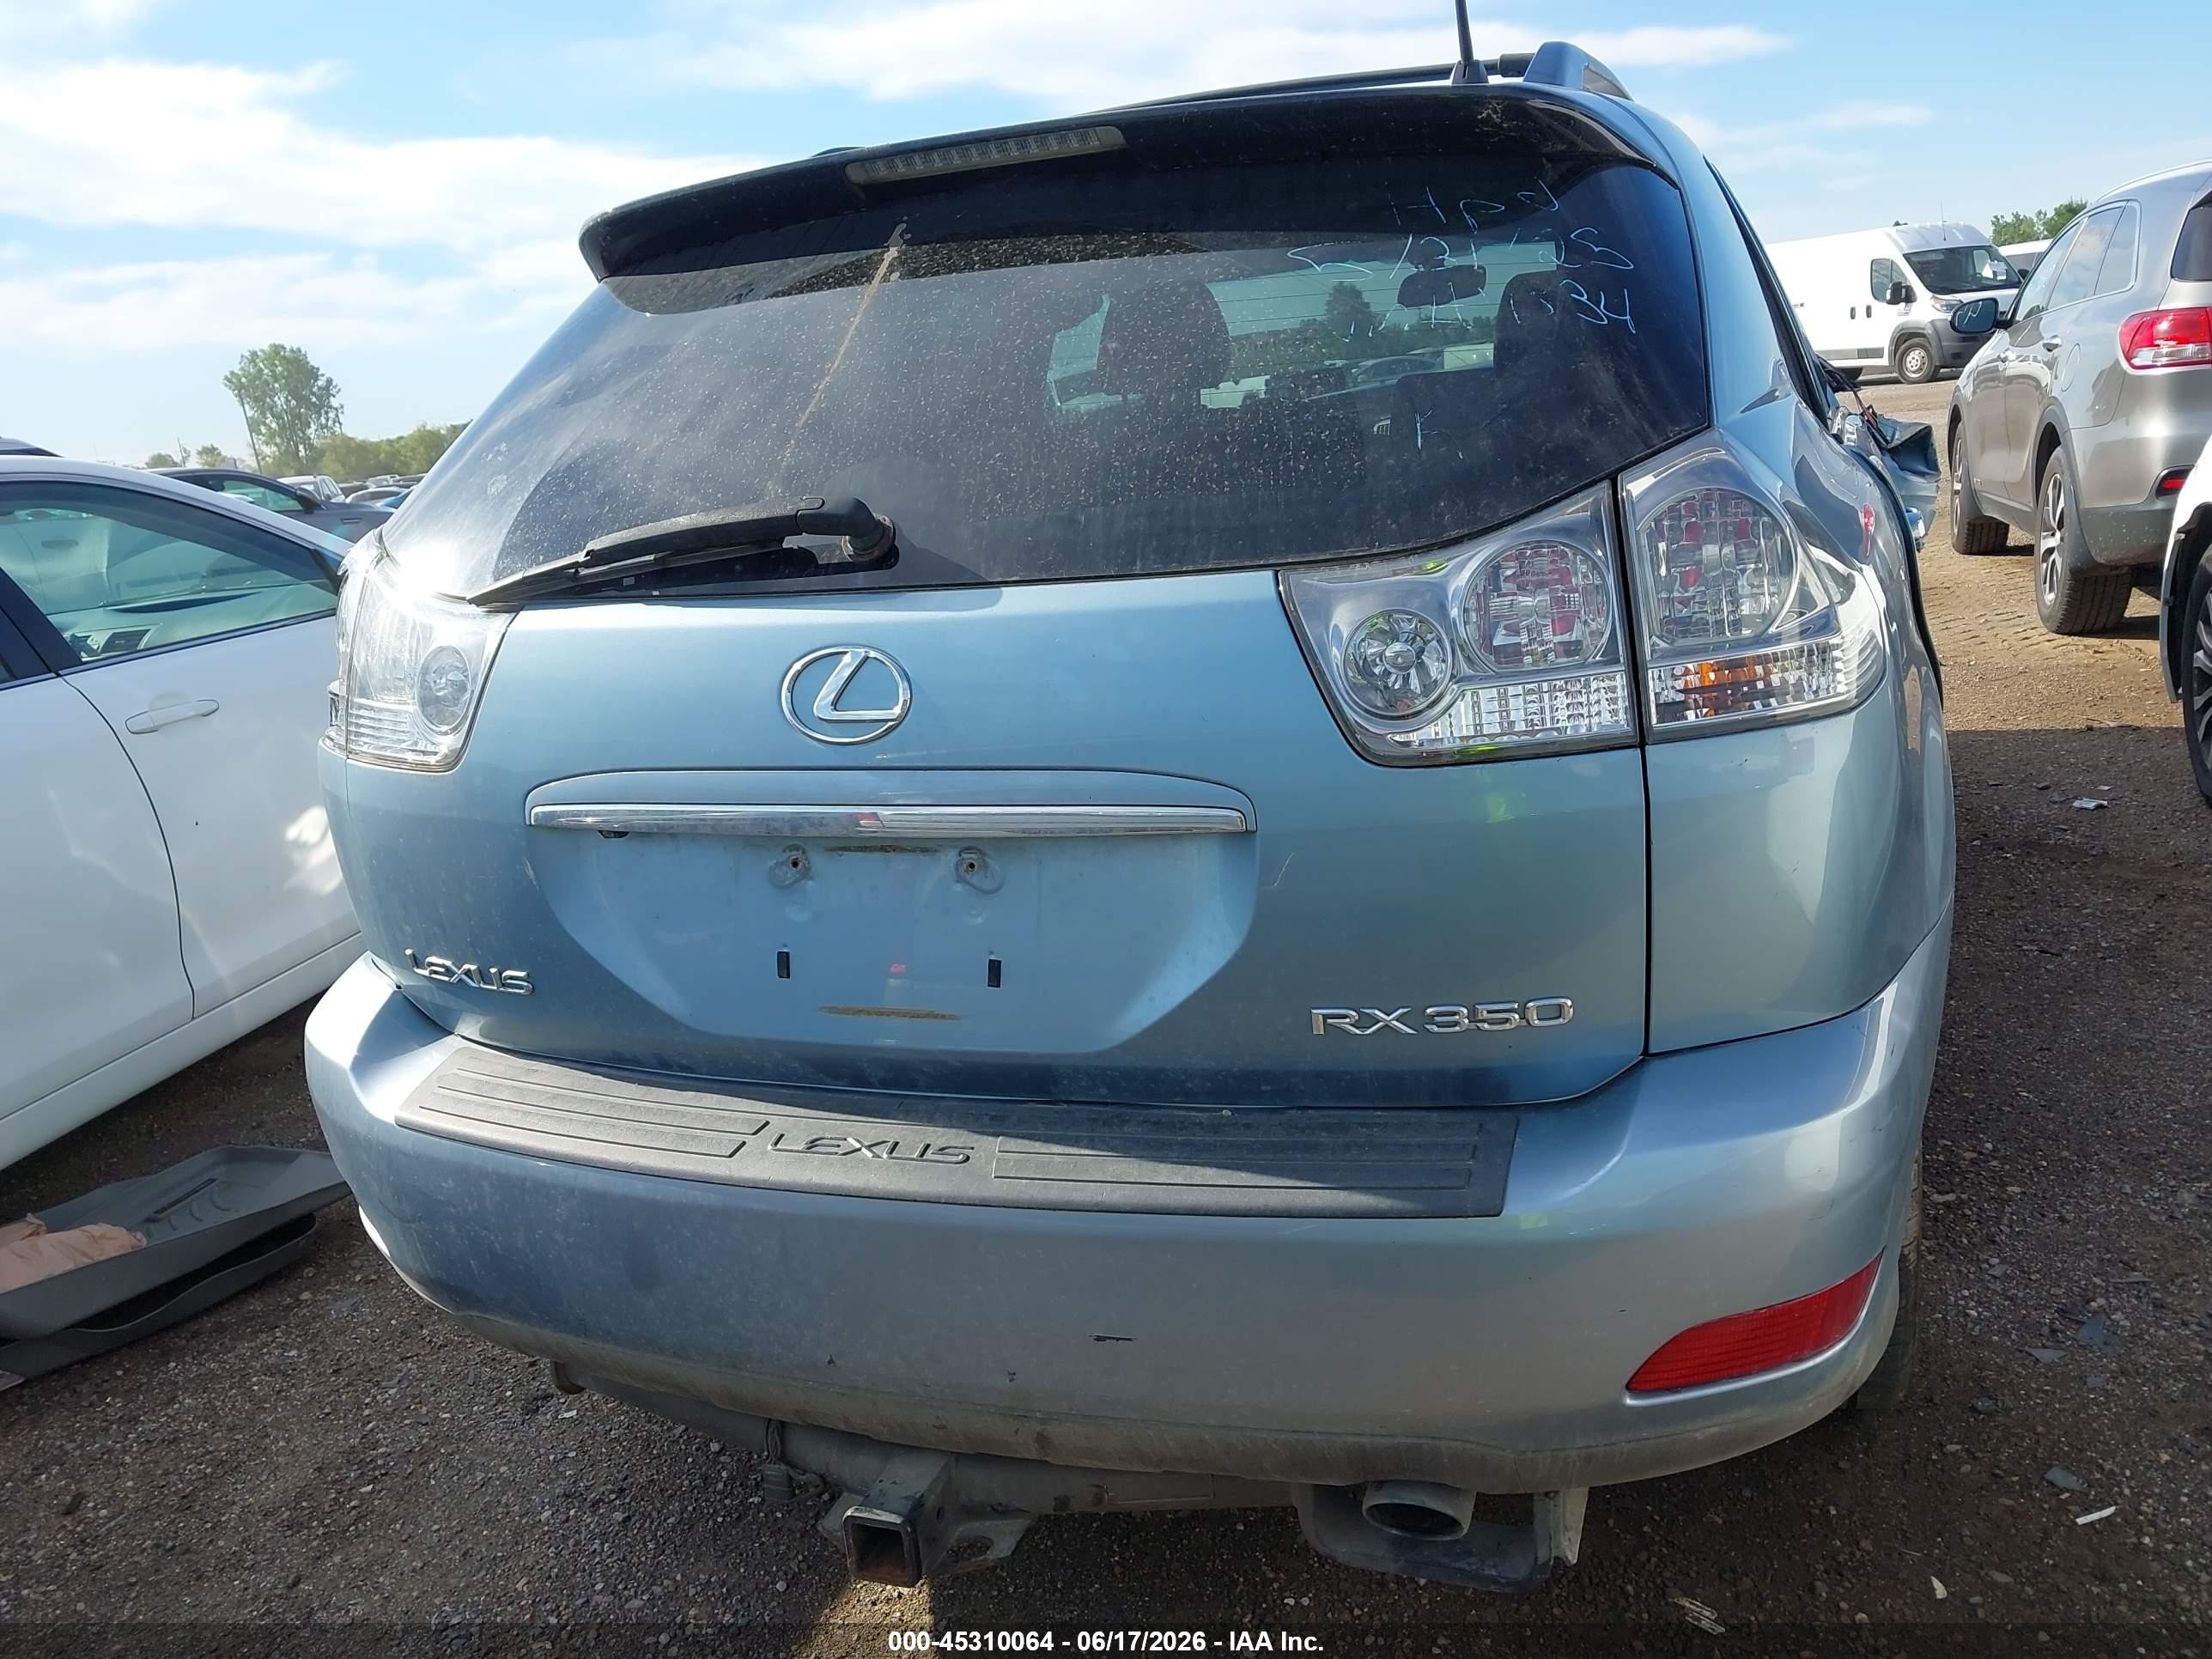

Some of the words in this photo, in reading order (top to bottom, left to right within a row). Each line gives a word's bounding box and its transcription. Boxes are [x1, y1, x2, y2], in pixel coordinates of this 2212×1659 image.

[404, 948, 534, 995] LEXUS
[1310, 1007, 1418, 1035] RX
[1422, 996, 1575, 1035] 350
[768, 1132, 975, 1165] LEXUS
